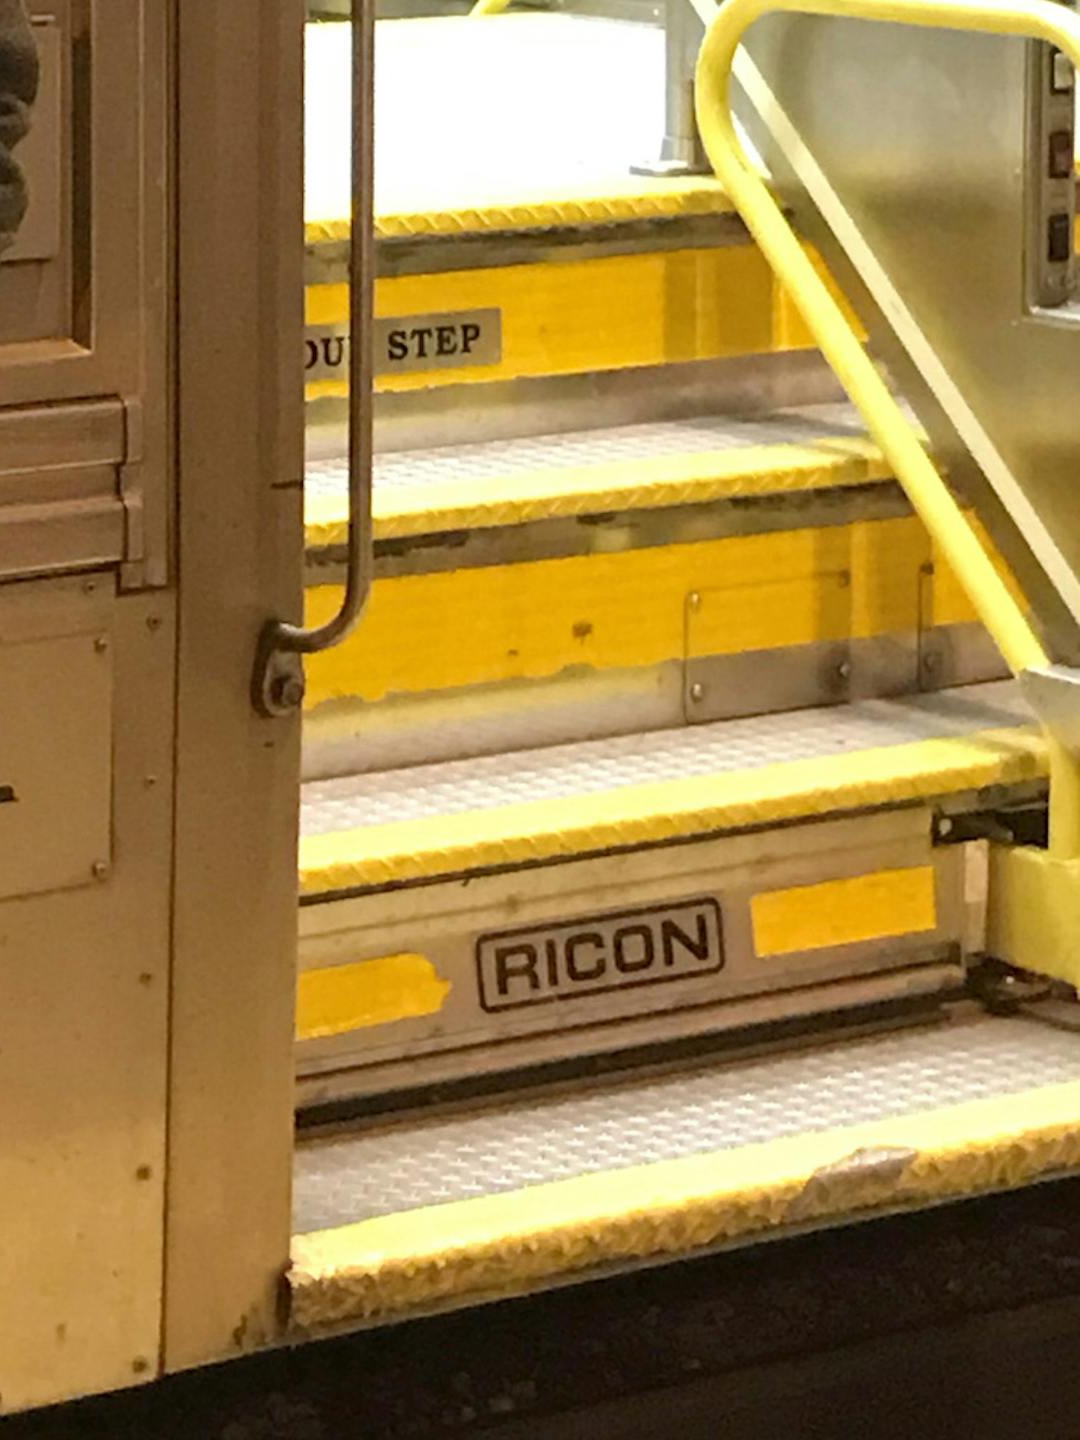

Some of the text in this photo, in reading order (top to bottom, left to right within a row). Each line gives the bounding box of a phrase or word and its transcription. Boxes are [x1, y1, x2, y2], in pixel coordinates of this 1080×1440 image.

[304, 323, 480, 369] OU STEP
[494, 914, 709, 995] RICON
